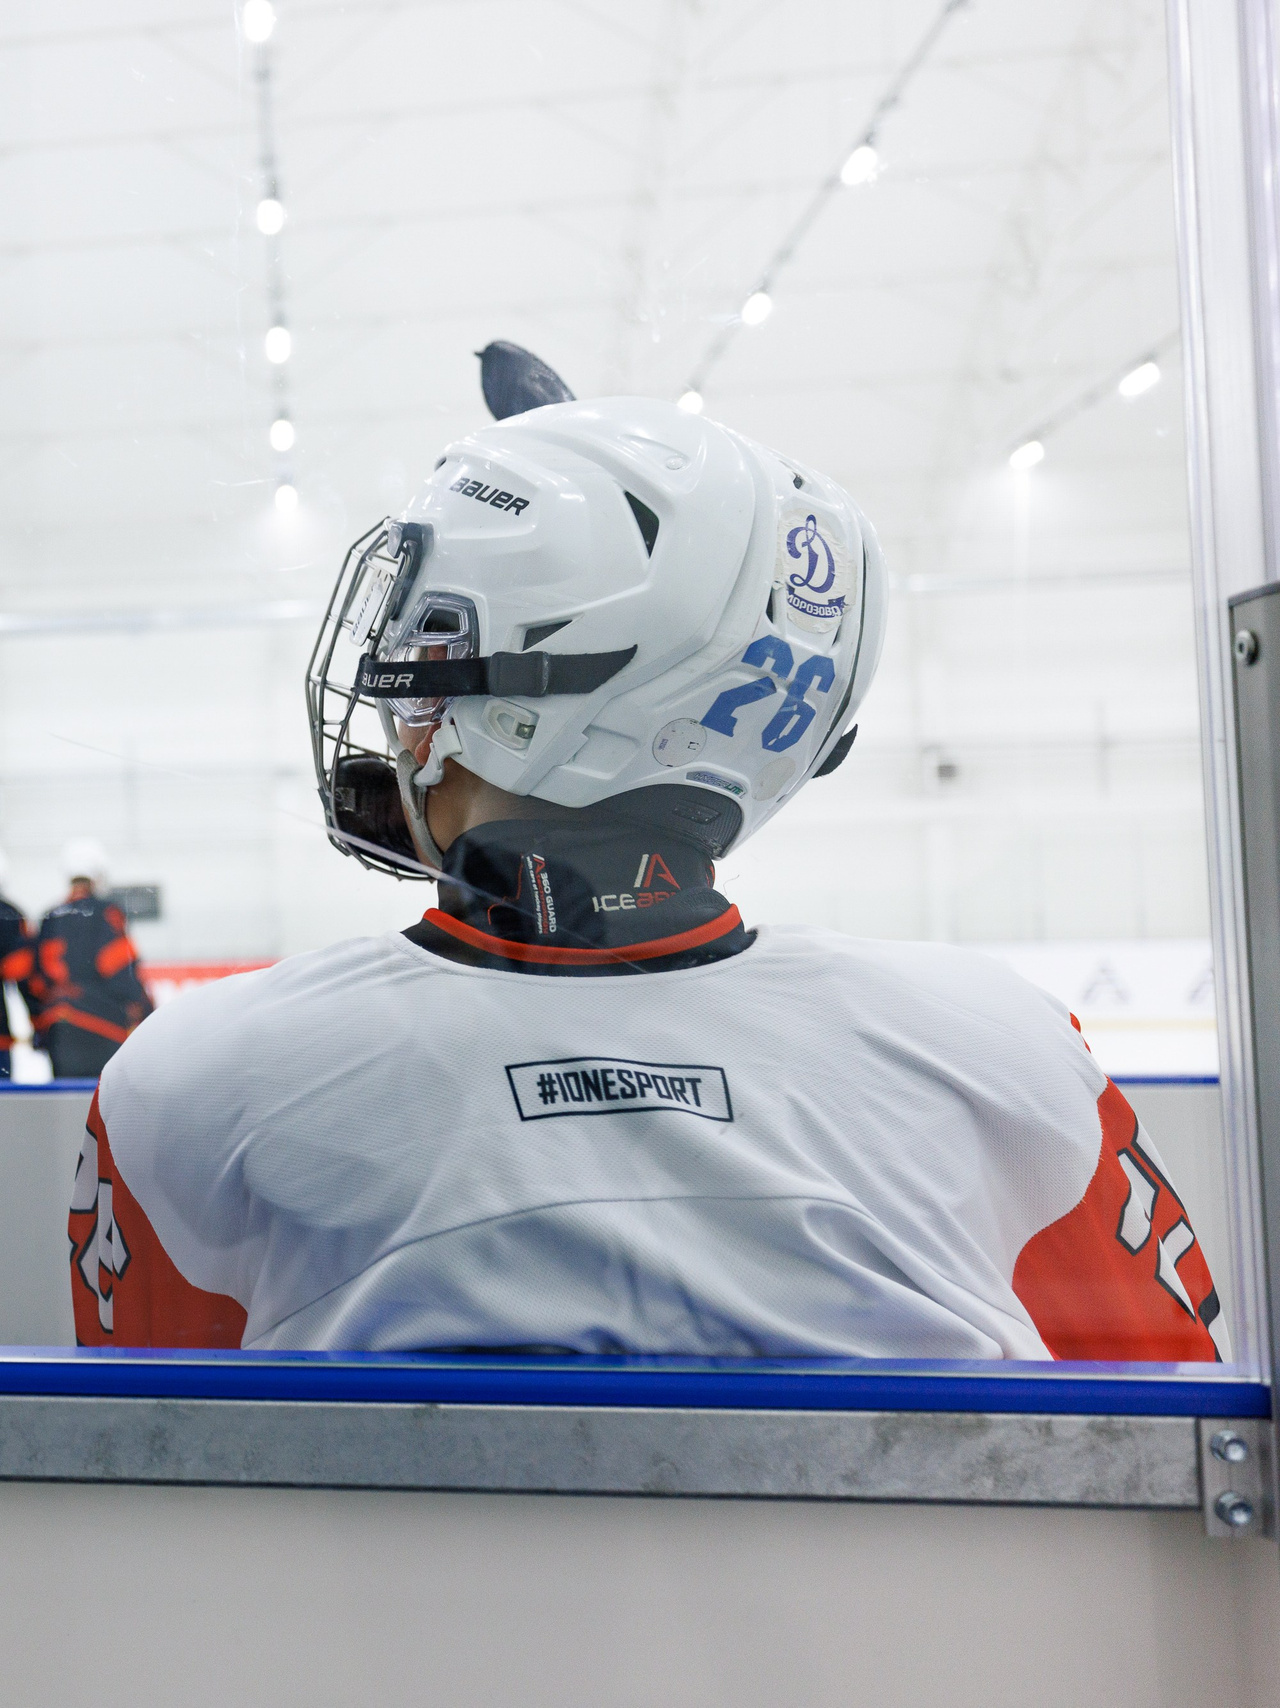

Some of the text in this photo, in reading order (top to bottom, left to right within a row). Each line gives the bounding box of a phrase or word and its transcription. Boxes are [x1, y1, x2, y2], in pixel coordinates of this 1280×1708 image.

[699, 634, 836, 753] 26
[540, 872, 557, 933] 360 GUARD
